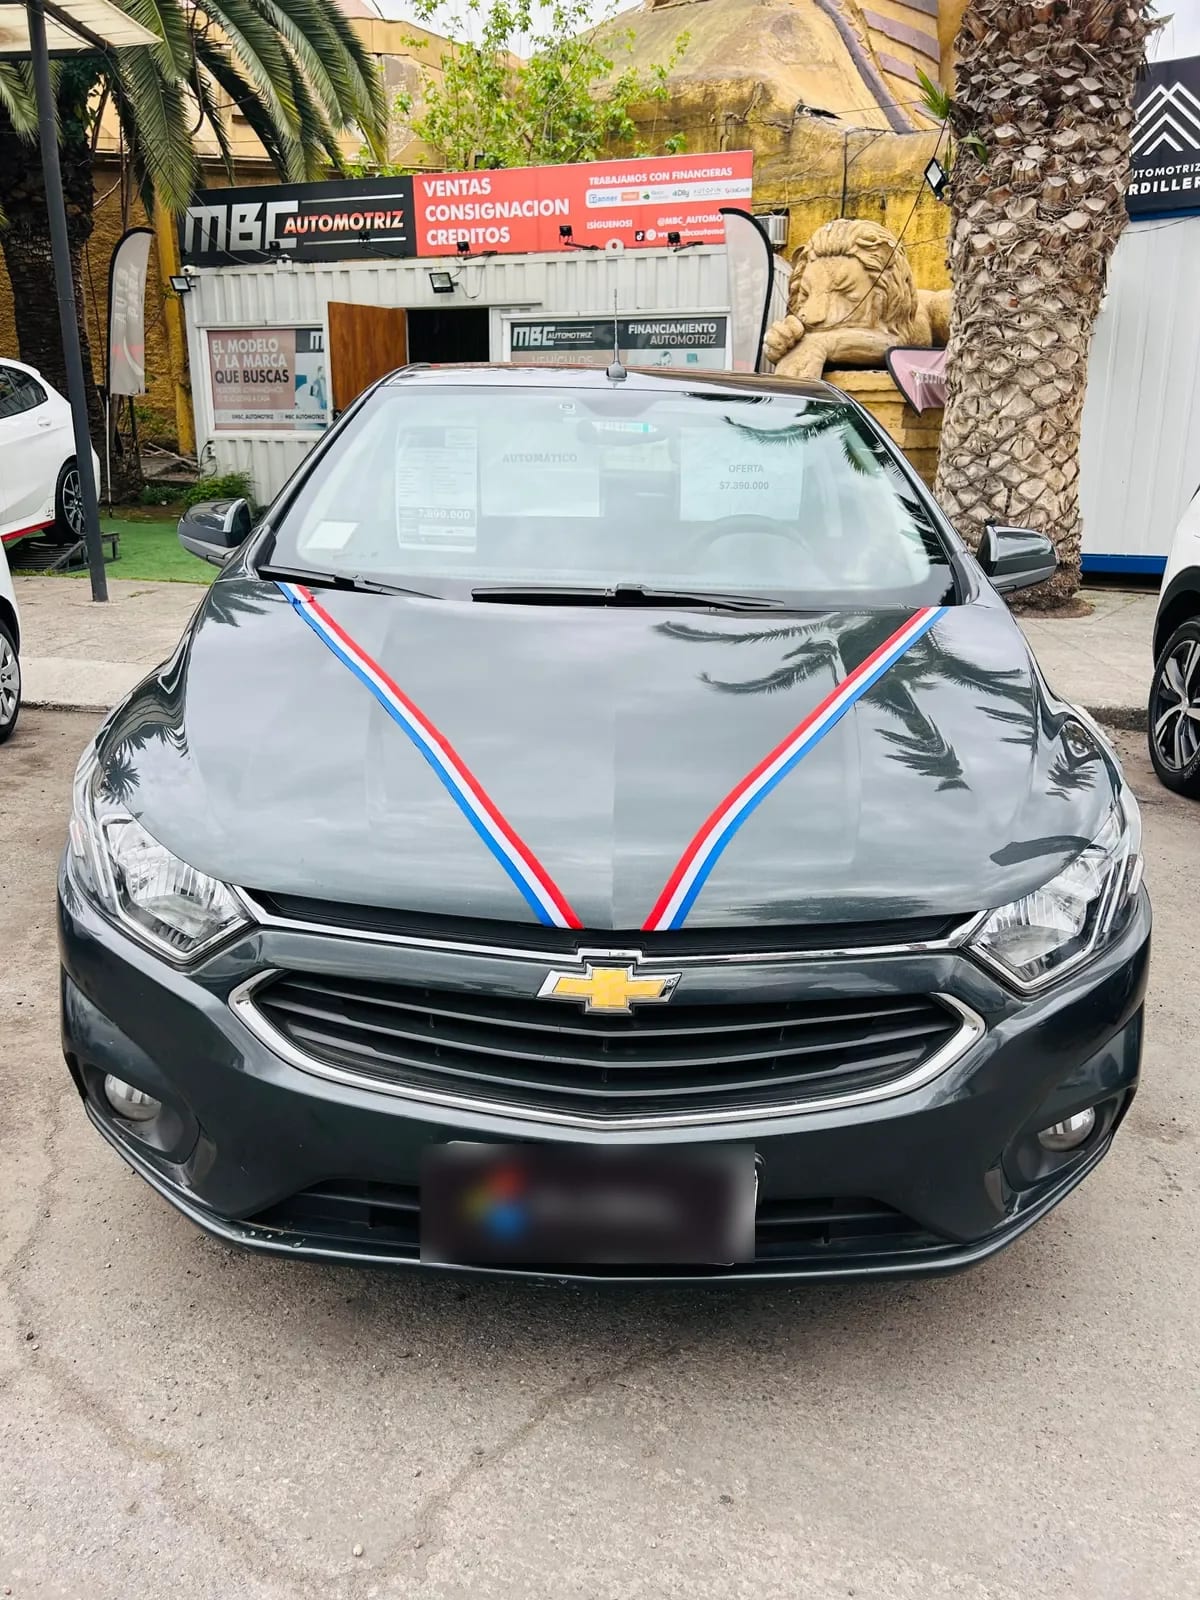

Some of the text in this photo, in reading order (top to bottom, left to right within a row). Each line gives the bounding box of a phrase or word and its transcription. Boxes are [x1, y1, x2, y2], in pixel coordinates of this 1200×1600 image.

[589, 167, 733, 185] TRABAJAMOS CON FINANCIERAS
[423, 178, 492, 197] VENTAS
[1127, 176, 1200, 196] RDILLER
[425, 198, 570, 222] CONSIGNACION
[184, 200, 299, 252] MBC
[283, 210, 404, 235] AUTOMOTRIZ
[657, 214, 724, 227] @MBC_AUTOMO
[426, 226, 511, 246] CREDITOS
[512, 326, 556, 347] MBC
[547, 331, 593, 339] AUTOMOTRIZ
[628, 323, 717, 335] FINANCIAMIENTO
[212, 338, 279, 353] EL MODELO
[650, 334, 717, 345] AUTOMOTRIZ
[213, 353, 288, 368] Y LA MARCA
[215, 369, 290, 384] QUE BUSCAS
[728, 464, 764, 473] OFERTA
